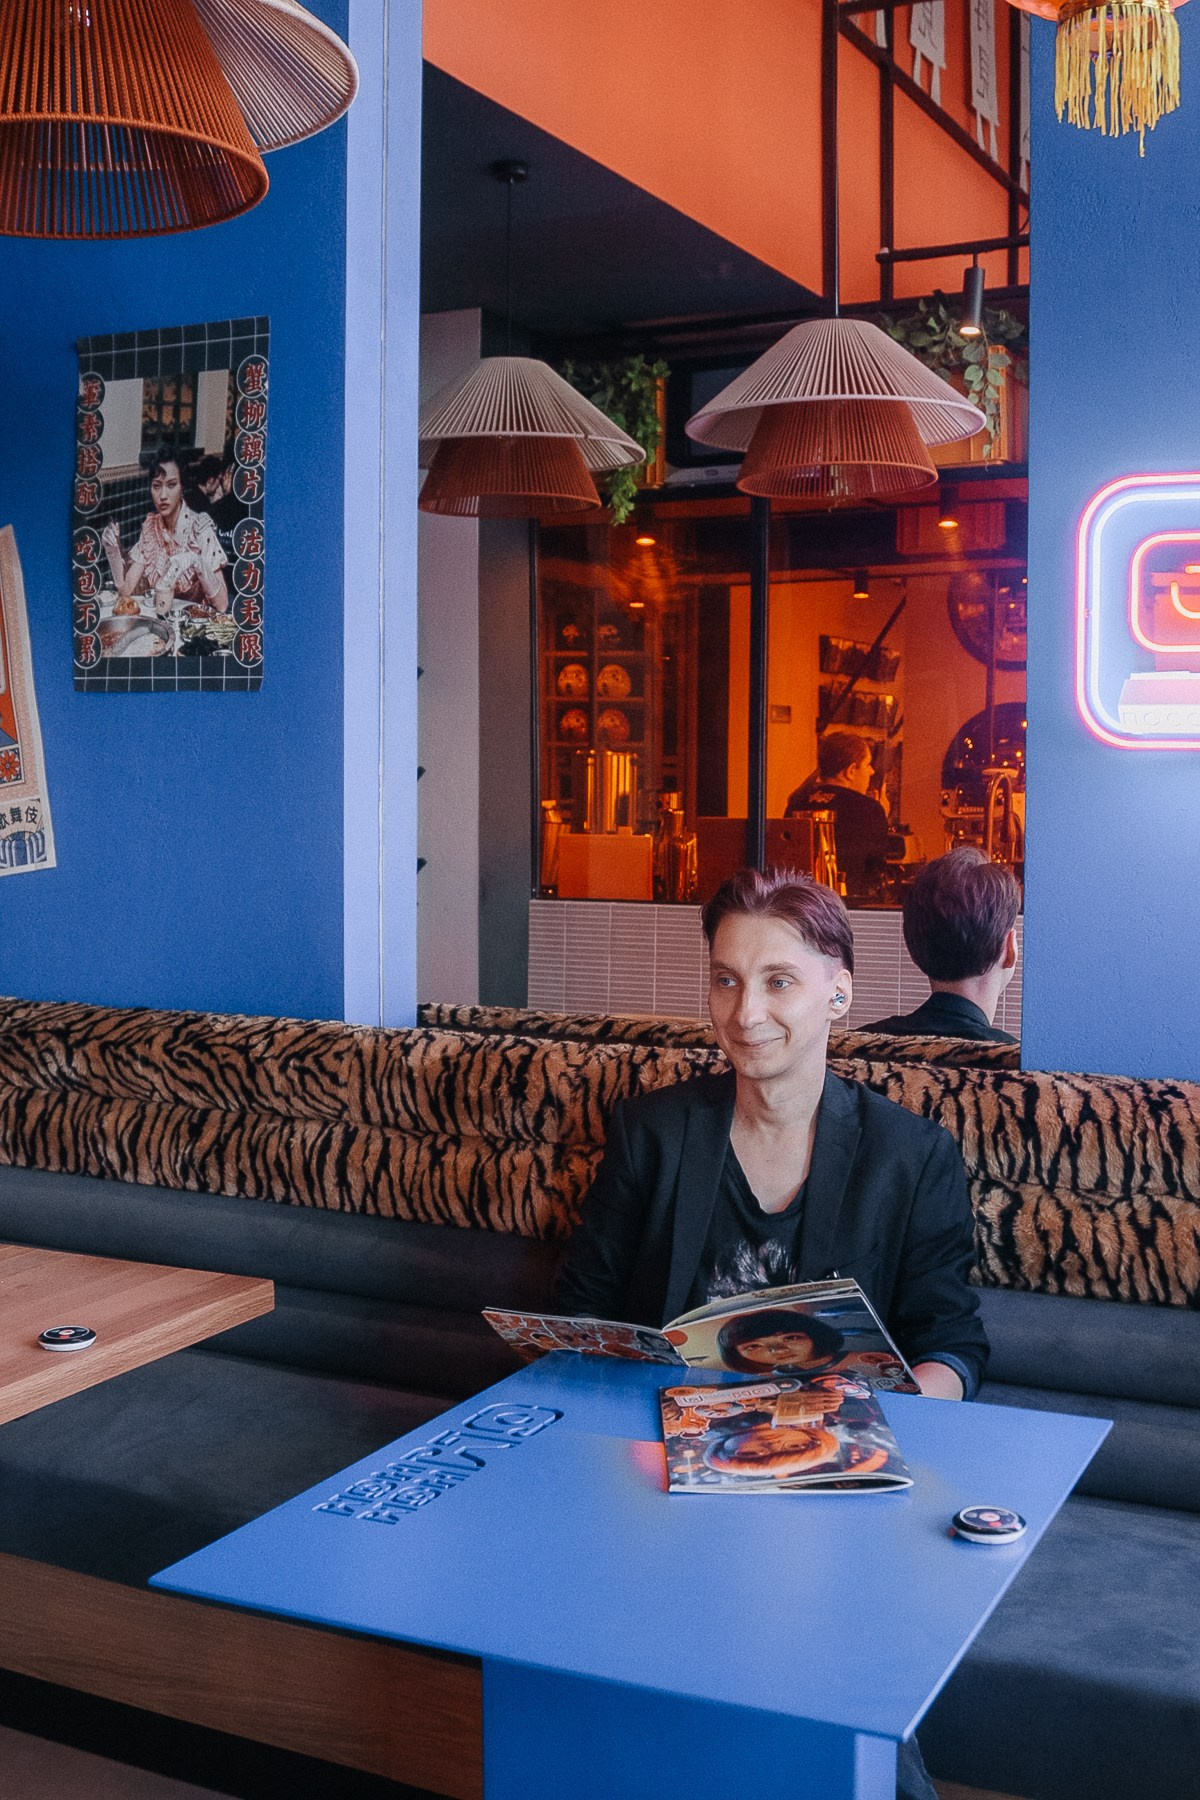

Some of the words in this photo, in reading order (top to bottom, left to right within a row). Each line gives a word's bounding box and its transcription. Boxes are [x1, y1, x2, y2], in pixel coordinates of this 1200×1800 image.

[239, 362, 267, 500] 蟹柳藕片
[239, 527, 264, 662] 活力无限
